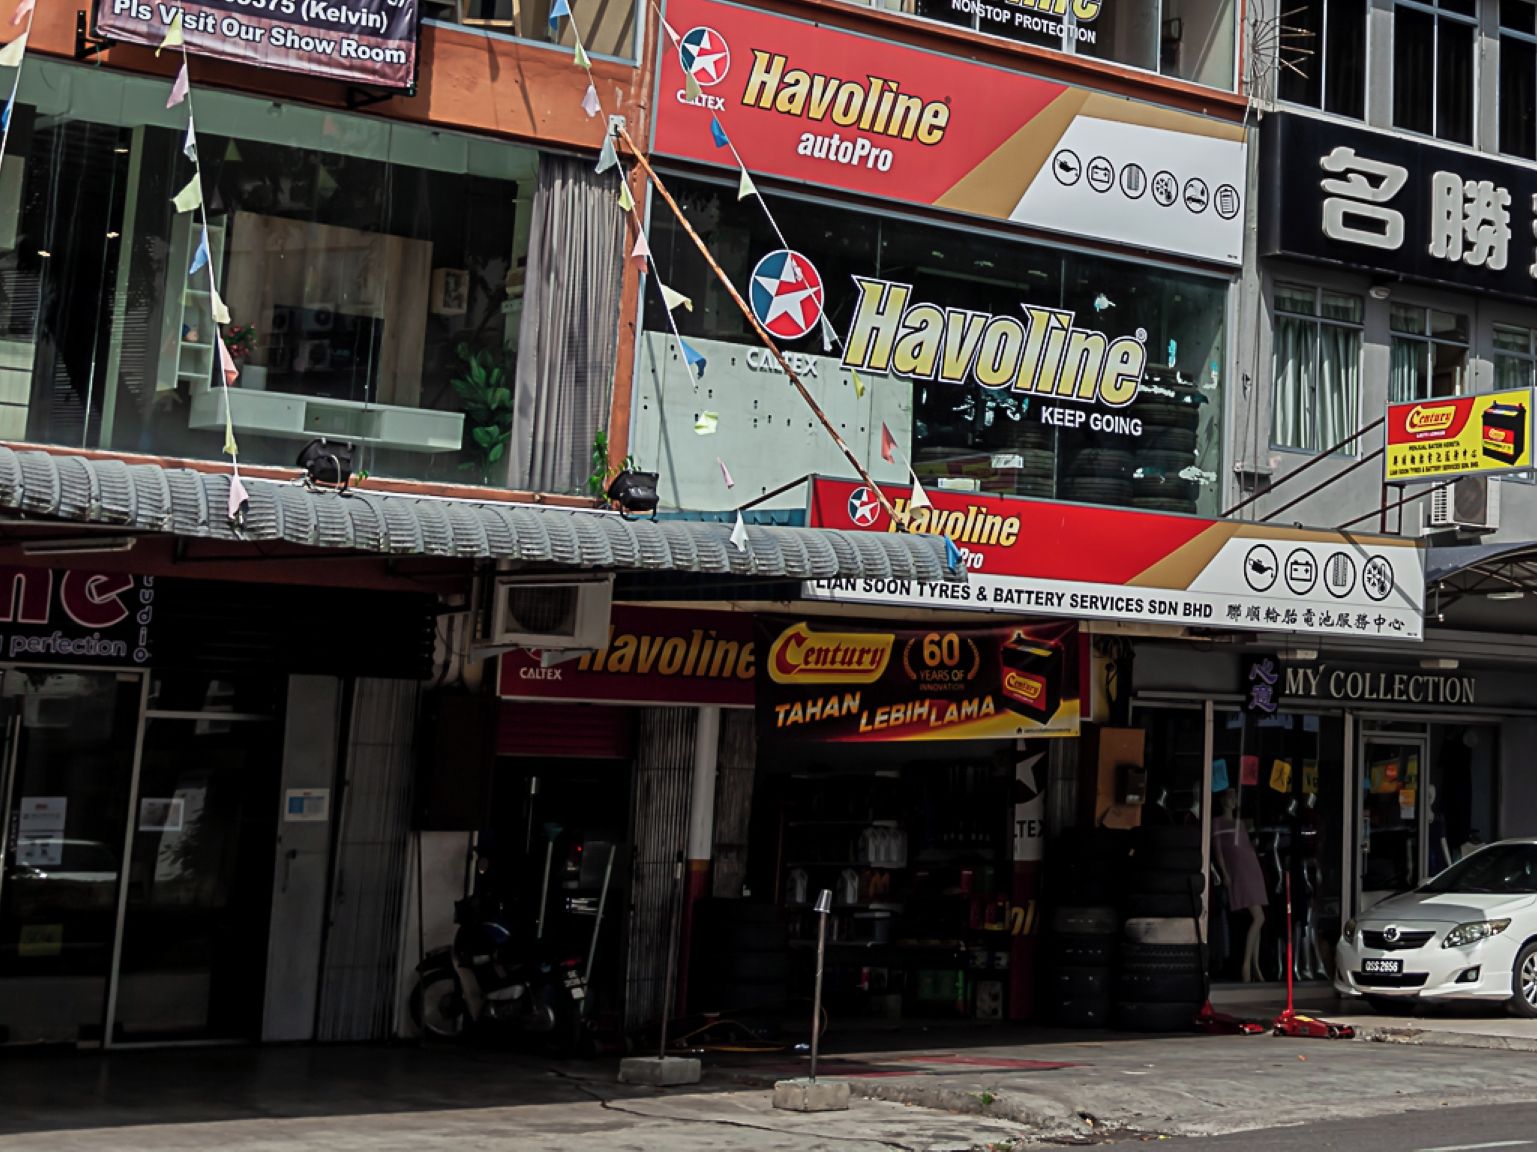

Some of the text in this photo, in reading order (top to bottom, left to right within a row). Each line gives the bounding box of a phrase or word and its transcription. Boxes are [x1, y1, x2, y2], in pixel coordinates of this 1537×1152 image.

[222, 17, 265, 43] Our
[269, 20, 334, 52] Show
[340, 37, 407, 65] Room
[1015, 13, 1096, 44] PROTECTION
[676, 89, 726, 112] CLTEX
[741, 49, 951, 146] Havoline
[797, 132, 894, 172] autoPro
[840, 274, 1148, 408] Havoline
[1041, 406, 1143, 437] KEEP GOING
[863, 579, 910, 595] SOON
[917, 582, 971, 599] TYRES
[977, 586, 987, 601] &
[993, 588, 1064, 607] BATTERY
[1069, 593, 1143, 613] SERVICES
[1148, 599, 1178, 616] SDN
[1183, 602, 1213, 618] BHD
[10, 630, 127, 658] perfection
[775, 632, 886, 676] Century
[923, 632, 960, 667] 60
[519, 666, 562, 680] CALTEX
[919, 669, 965, 682] YEARS OF
[1285, 664, 1476, 704] MY COLLECTION
[775, 691, 996, 733] TAHAN LEBIH LAMA
